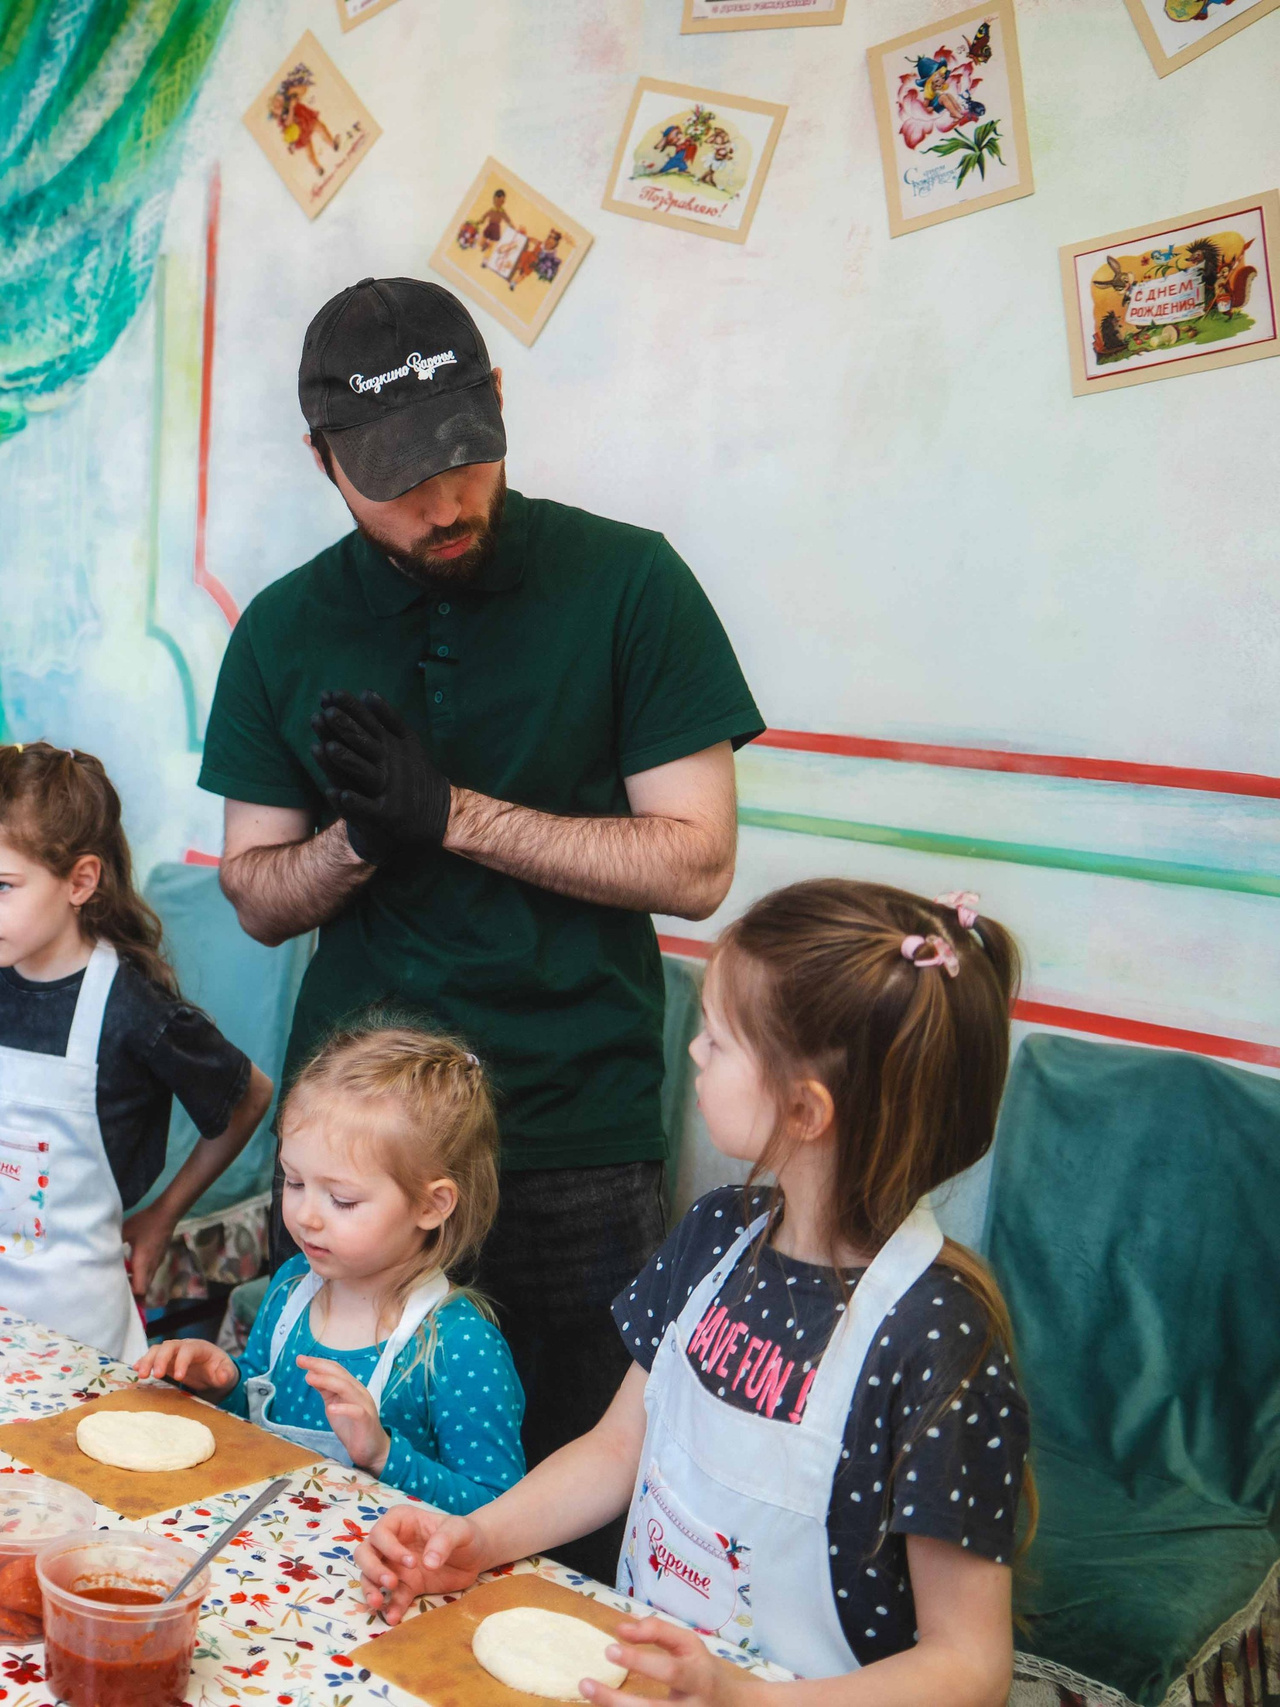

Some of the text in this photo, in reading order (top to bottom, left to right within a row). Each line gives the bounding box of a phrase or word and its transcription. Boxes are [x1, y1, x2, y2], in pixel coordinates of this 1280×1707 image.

[639, 185, 728, 218] Поздравляю!
[1134, 279, 1194, 303] С ДНЕМ
[348, 350, 457, 394] Сказкино Варенье
[731, 1335, 795, 1419] FUN
[647, 1518, 711, 1595] Варенье
